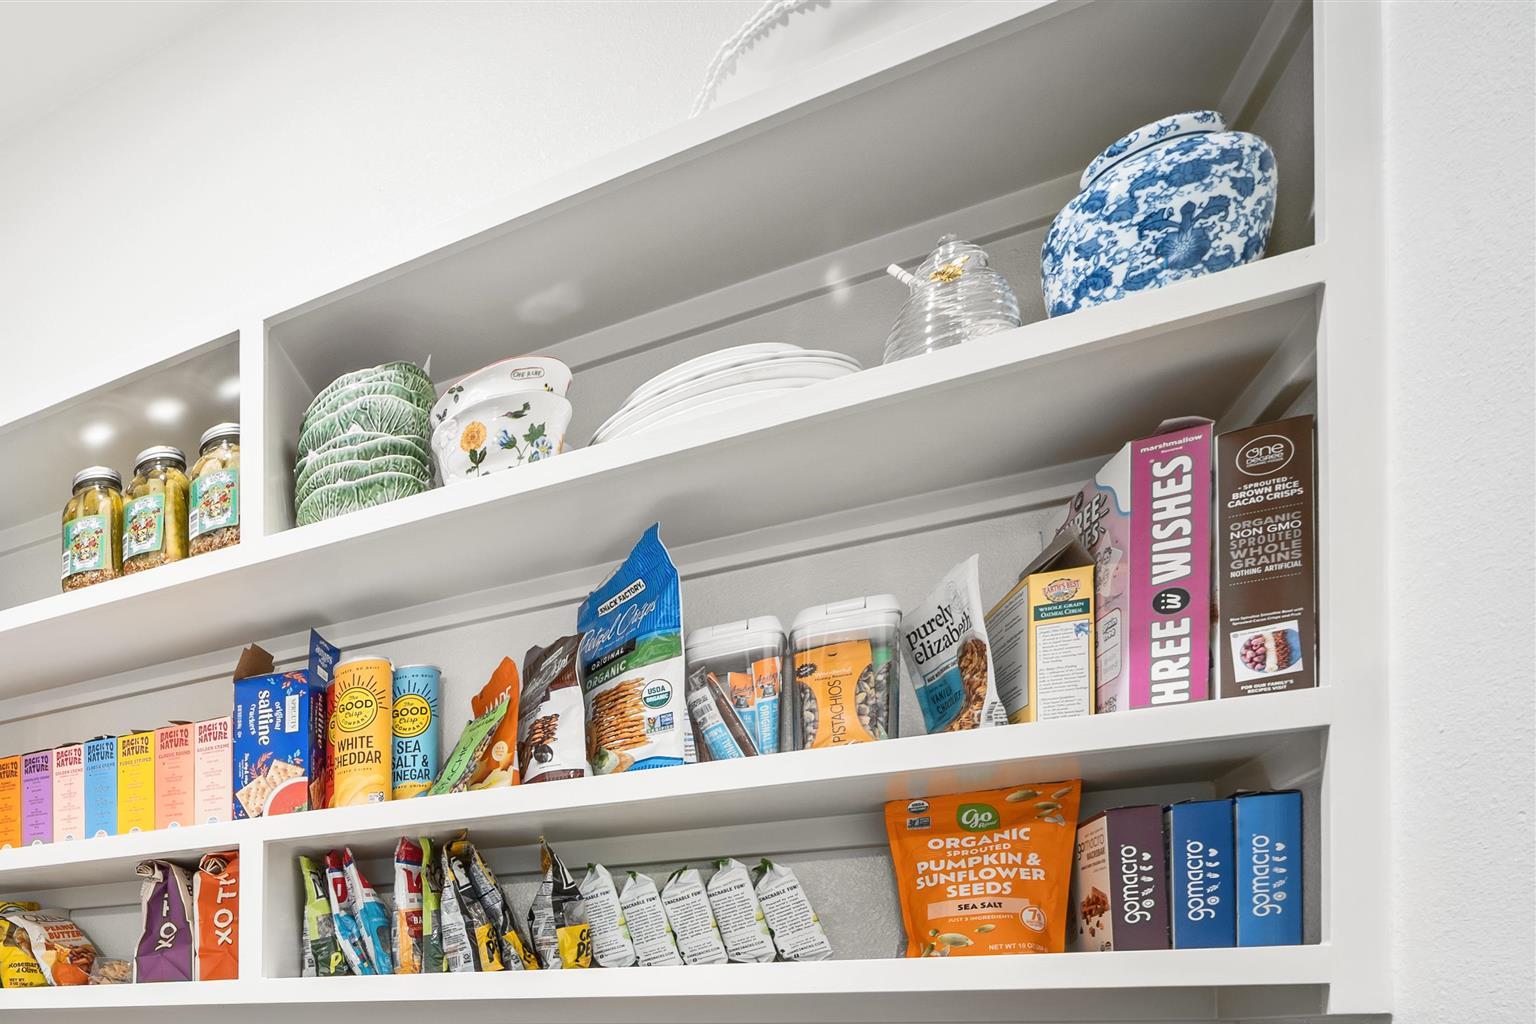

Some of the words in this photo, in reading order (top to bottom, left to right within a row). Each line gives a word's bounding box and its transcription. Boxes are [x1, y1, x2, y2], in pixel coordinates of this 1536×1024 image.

[1139, 433, 1204, 454] marshmallow
[1245, 443, 1284, 459] one
[1232, 486, 1272, 501] BROWN
[1274, 480, 1300, 490] RICE
[1243, 476, 1288, 490] SPROUTED
[1227, 495, 1264, 509] CACAO
[1265, 486, 1304, 501] CRISPS
[1151, 455, 1193, 587] WISHES
[1229, 510, 1302, 531] ORGANIC
[1229, 527, 1263, 540] NON
[1266, 519, 1302, 533] GMO
[1229, 528, 1302, 550] SPROUTED
[1229, 538, 1302, 560] WHOLE
[1229, 549, 1302, 571] GRAINS
[1229, 565, 1263, 579] NOTHING
[1264, 560, 1302, 573] ARTIFICIAL
[617, 581, 645, 603] FACTORY
[905, 603, 954, 652] purely
[914, 611, 973, 666] elizabeth
[591, 648, 624, 671] ORIGINAL
[1151, 617, 1191, 706] HREE
[586, 660, 627, 689] ORGANIC
[647, 685, 666, 695] USDA
[338, 700, 374, 712] GOOD
[392, 706, 428, 718] GOOD
[827, 679, 846, 743] PISTACHIOS
[258, 690, 274, 746] saltine
[160, 739, 189, 750] NATURE
[198, 732, 228, 744] NATURE
[337, 735, 374, 753] WHITE
[396, 739, 422, 755] SEA
[88, 752, 114, 763] NATURE
[122, 746, 149, 757] NATURE
[335, 750, 382, 770] CHEDDAR
[24, 764, 49, 775] NATURE
[56, 757, 82, 768] NATURE
[961, 808, 993, 828] go
[927, 827, 1031, 850] ORGANIC
[946, 842, 1012, 858] SPROUTED
[916, 852, 1022, 875] PUMPKIN
[1026, 852, 1042, 866] &
[916, 867, 1046, 890] SUNFLOWER
[1121, 843, 1151, 924] gomacro
[1187, 840, 1216, 921] gomacro
[1252, 834, 1282, 917] gomacro
[946, 881, 1013, 898] SEEDS
[957, 902, 978, 911] SEA
[980, 901, 1003, 909] SALT
[214, 907, 234, 946] XO
[970, 913, 1014, 922] INGREDIENTS
